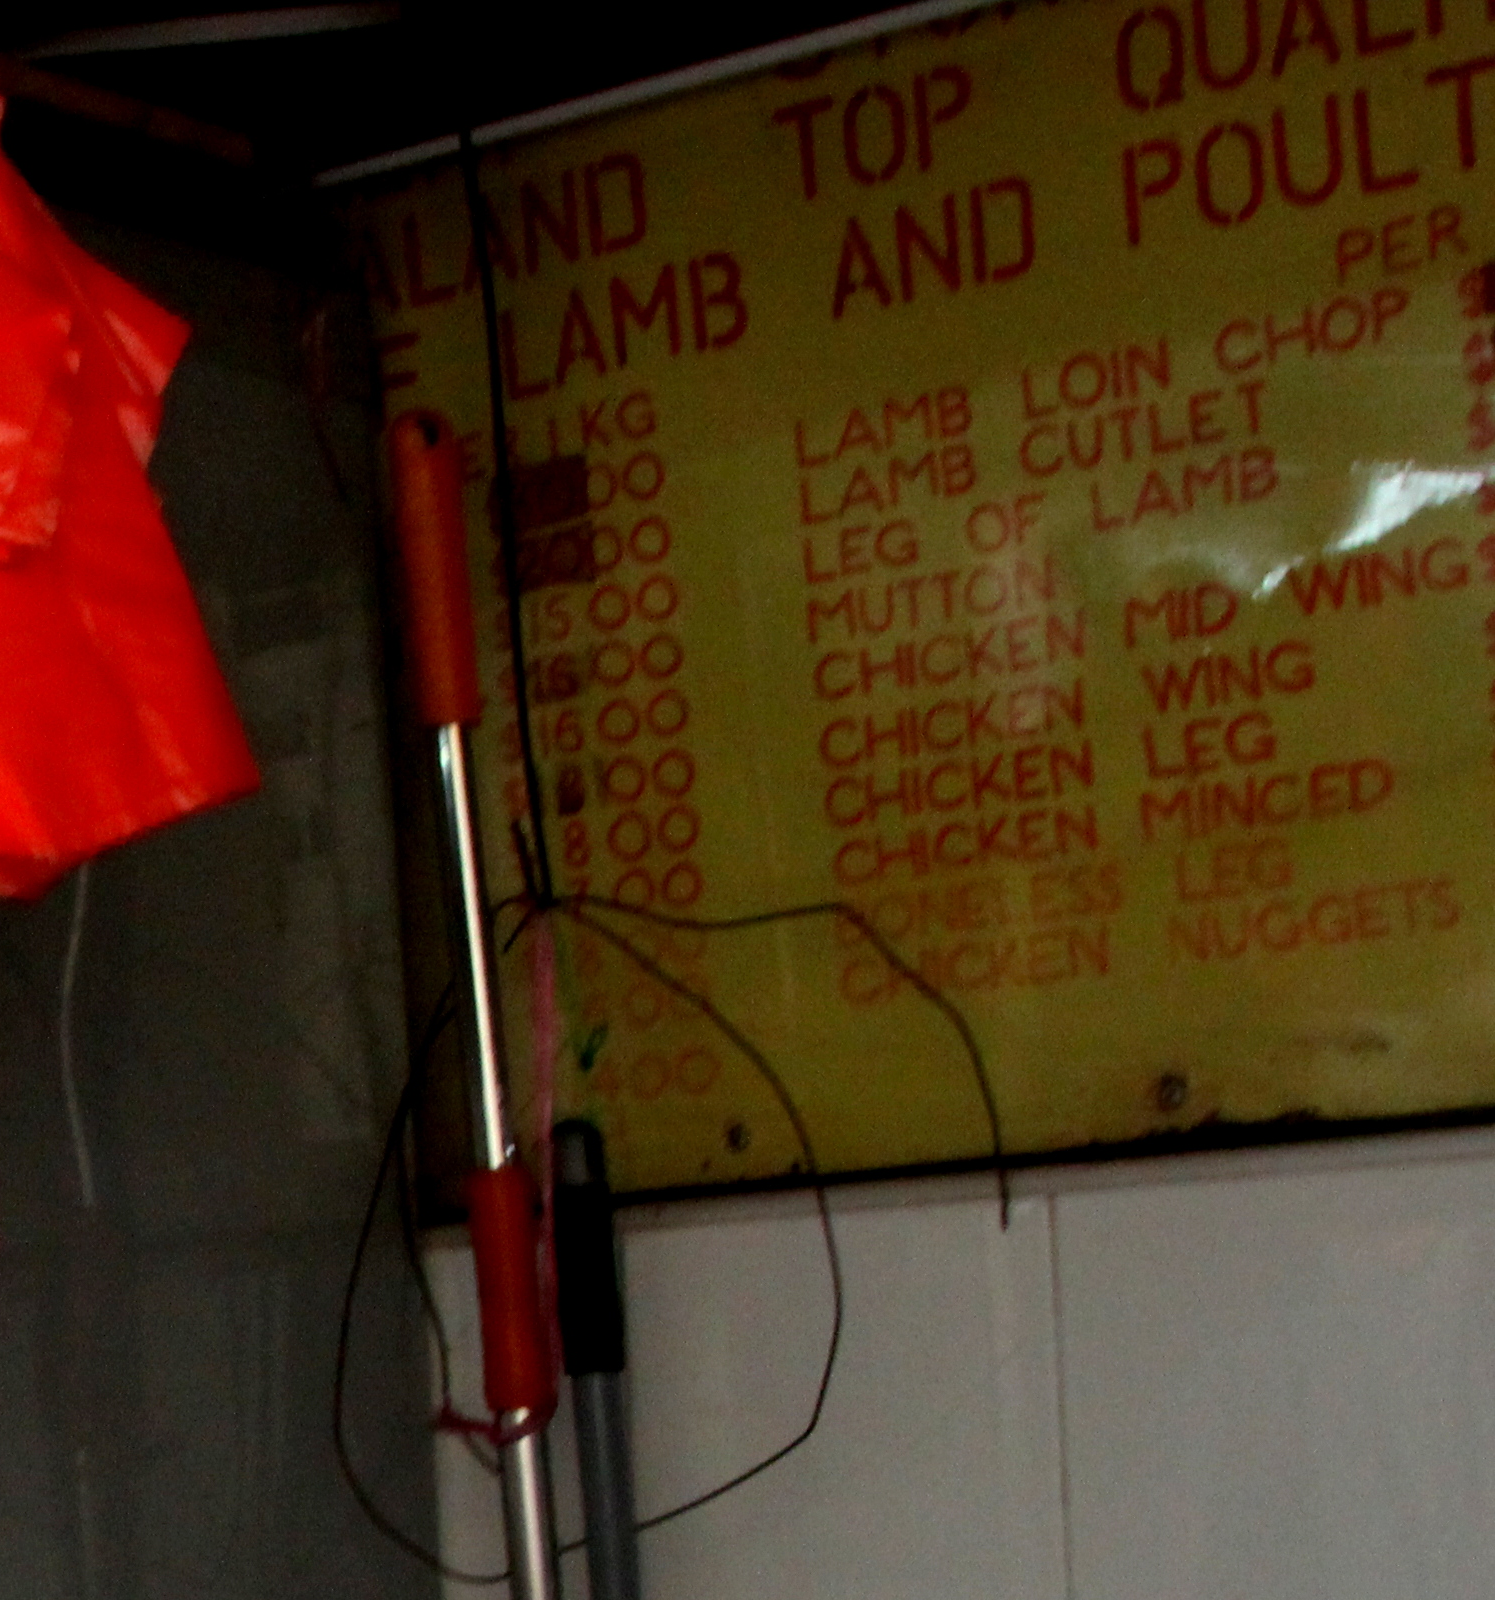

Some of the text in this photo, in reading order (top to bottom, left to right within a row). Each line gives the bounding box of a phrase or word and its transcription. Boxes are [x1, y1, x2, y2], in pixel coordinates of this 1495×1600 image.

[773, 65, 972, 201] TOP
[501, 253, 748, 401] LAMB
[832, 174, 1036, 322] AND
[1335, 203, 1471, 288] PER
[795, 384, 973, 468] LAMB
[1022, 334, 1171, 420] LOIN
[1214, 287, 1409, 375] CHOP
[800, 381, 1265, 526] LAMB CUTLET
[804, 446, 1277, 585] LEG OF LAMB
[805, 553, 1055, 645] MUTTON
[813, 537, 1469, 700] CHICKEN MID WING
[819, 639, 1315, 768] CHICKEN WING
[824, 710, 1277, 828] CHICKEN LEG
[832, 758, 1394, 887] CHICKEN MINCED
[1167, 879, 1462, 962] NUGGETS
[1175, 836, 1294, 902] LEG
